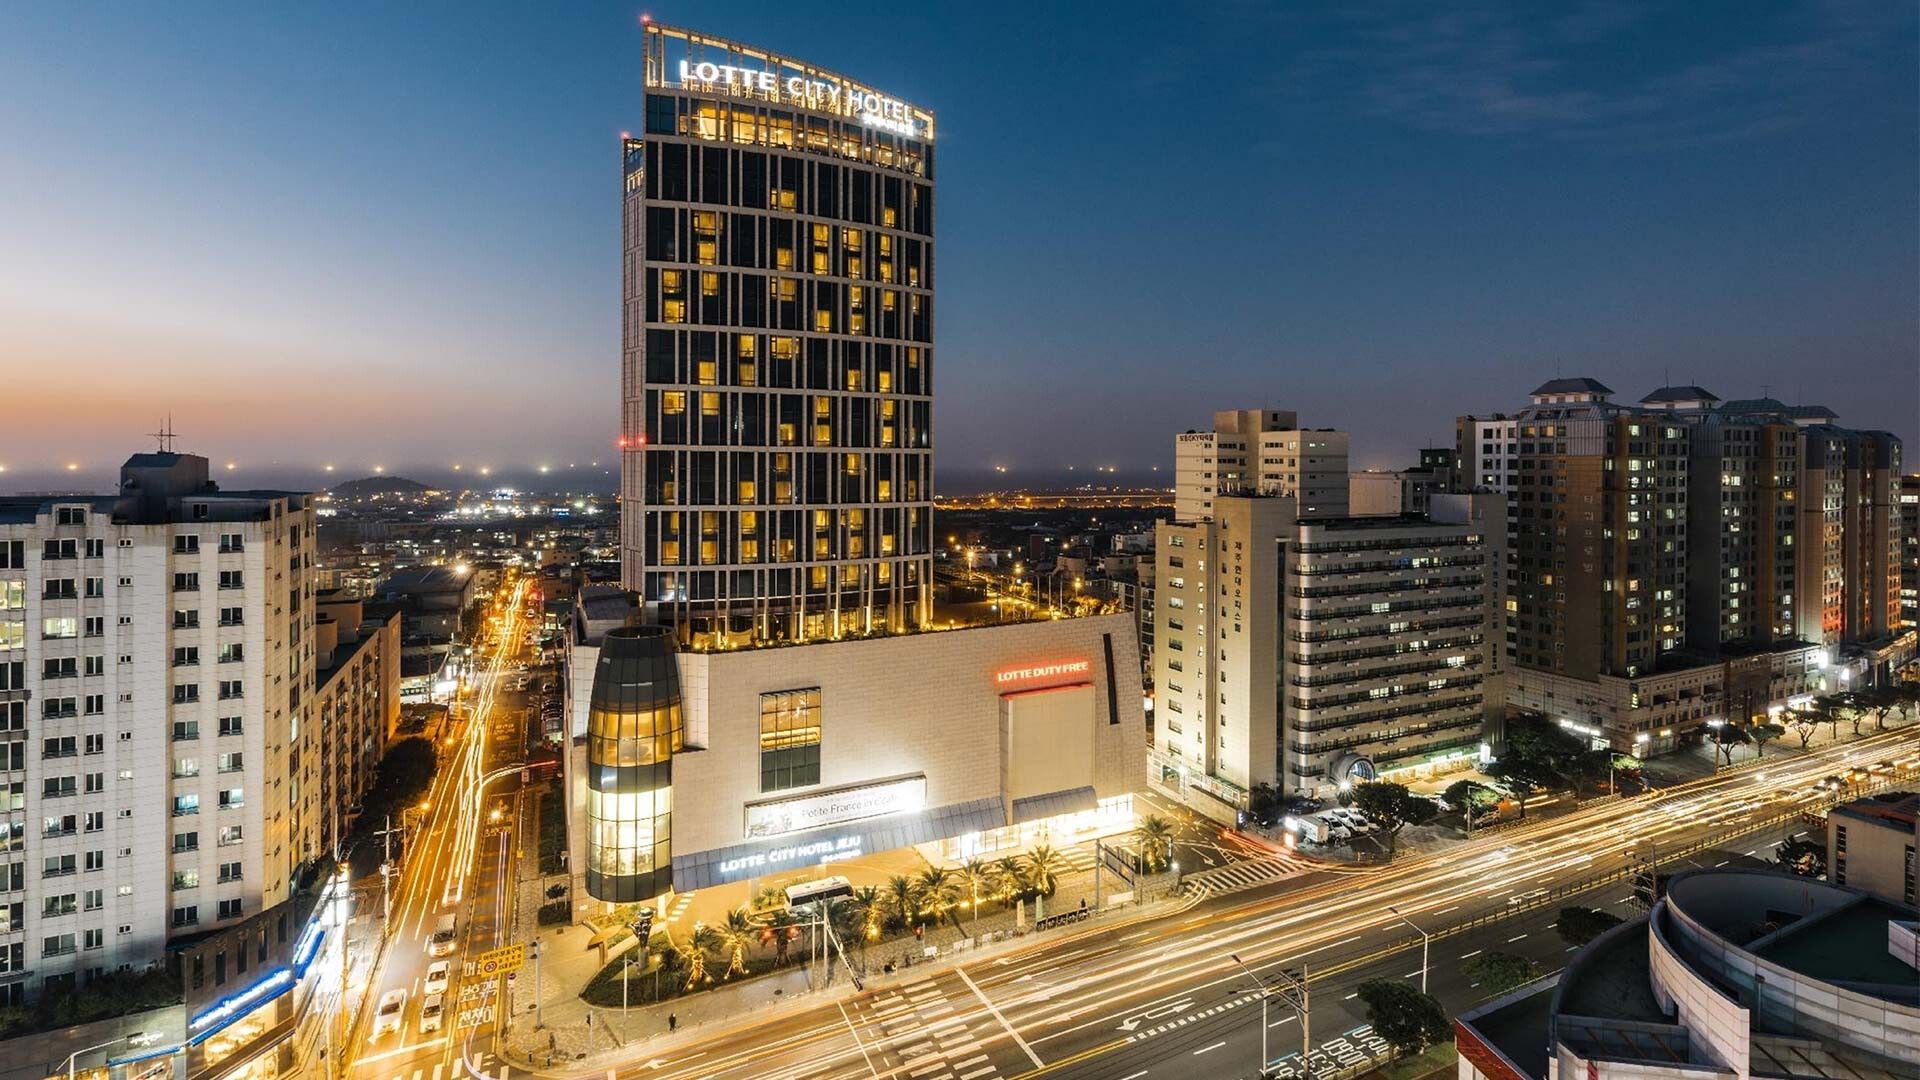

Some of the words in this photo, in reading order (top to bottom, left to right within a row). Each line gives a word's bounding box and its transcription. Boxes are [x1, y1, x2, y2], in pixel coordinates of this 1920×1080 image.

[679, 60, 776, 91] LOTTE
[787, 77, 841, 104] CITY
[847, 89, 912, 123] HOTEL
[998, 669, 1033, 682] LOTTE
[1033, 665, 1061, 677] DUTY
[1062, 661, 1088, 673] FREE
[720, 854, 766, 873] LOTTE
[768, 848, 797, 862] CITY
[797, 841, 834, 857] HOTEL
[836, 835, 861, 850] JEJU
